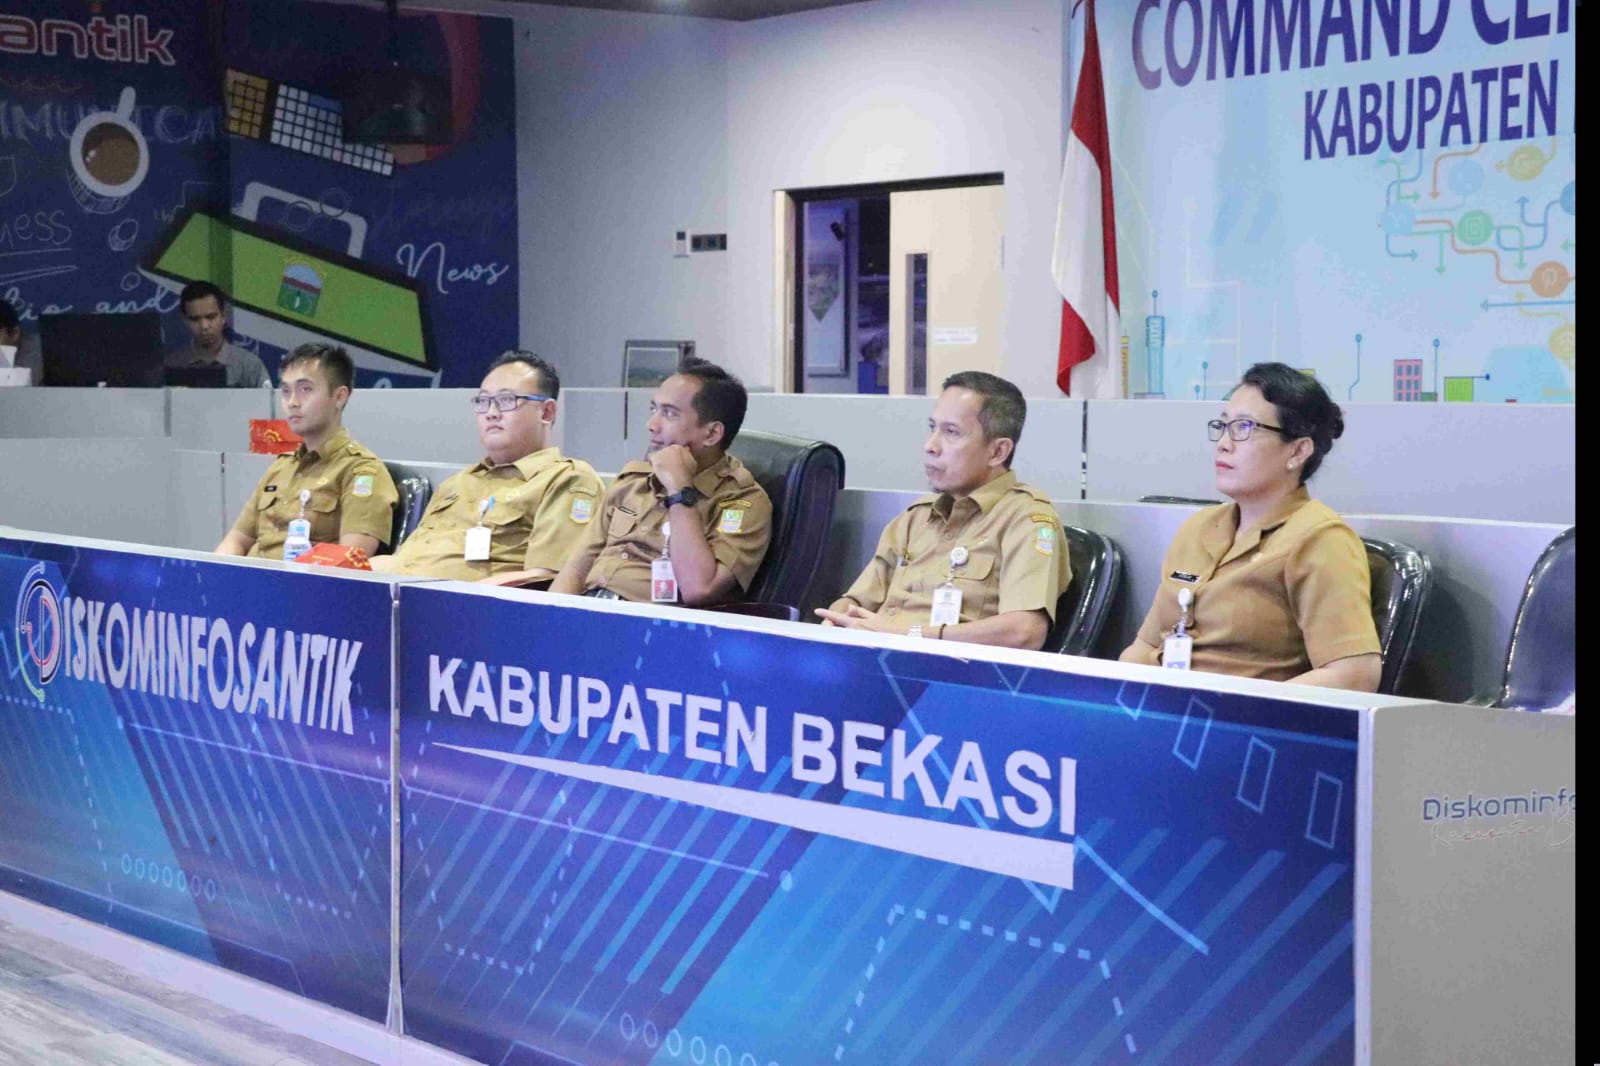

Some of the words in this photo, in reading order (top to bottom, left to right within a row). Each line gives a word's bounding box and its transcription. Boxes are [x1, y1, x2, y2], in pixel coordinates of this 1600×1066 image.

[1132, 0, 1451, 90] COMMAND
[1304, 60, 1559, 160] KABUPATEN
[396, 242, 509, 294] News
[427, 654, 767, 773] KABUPATEN
[791, 712, 1077, 835] BEKASI
